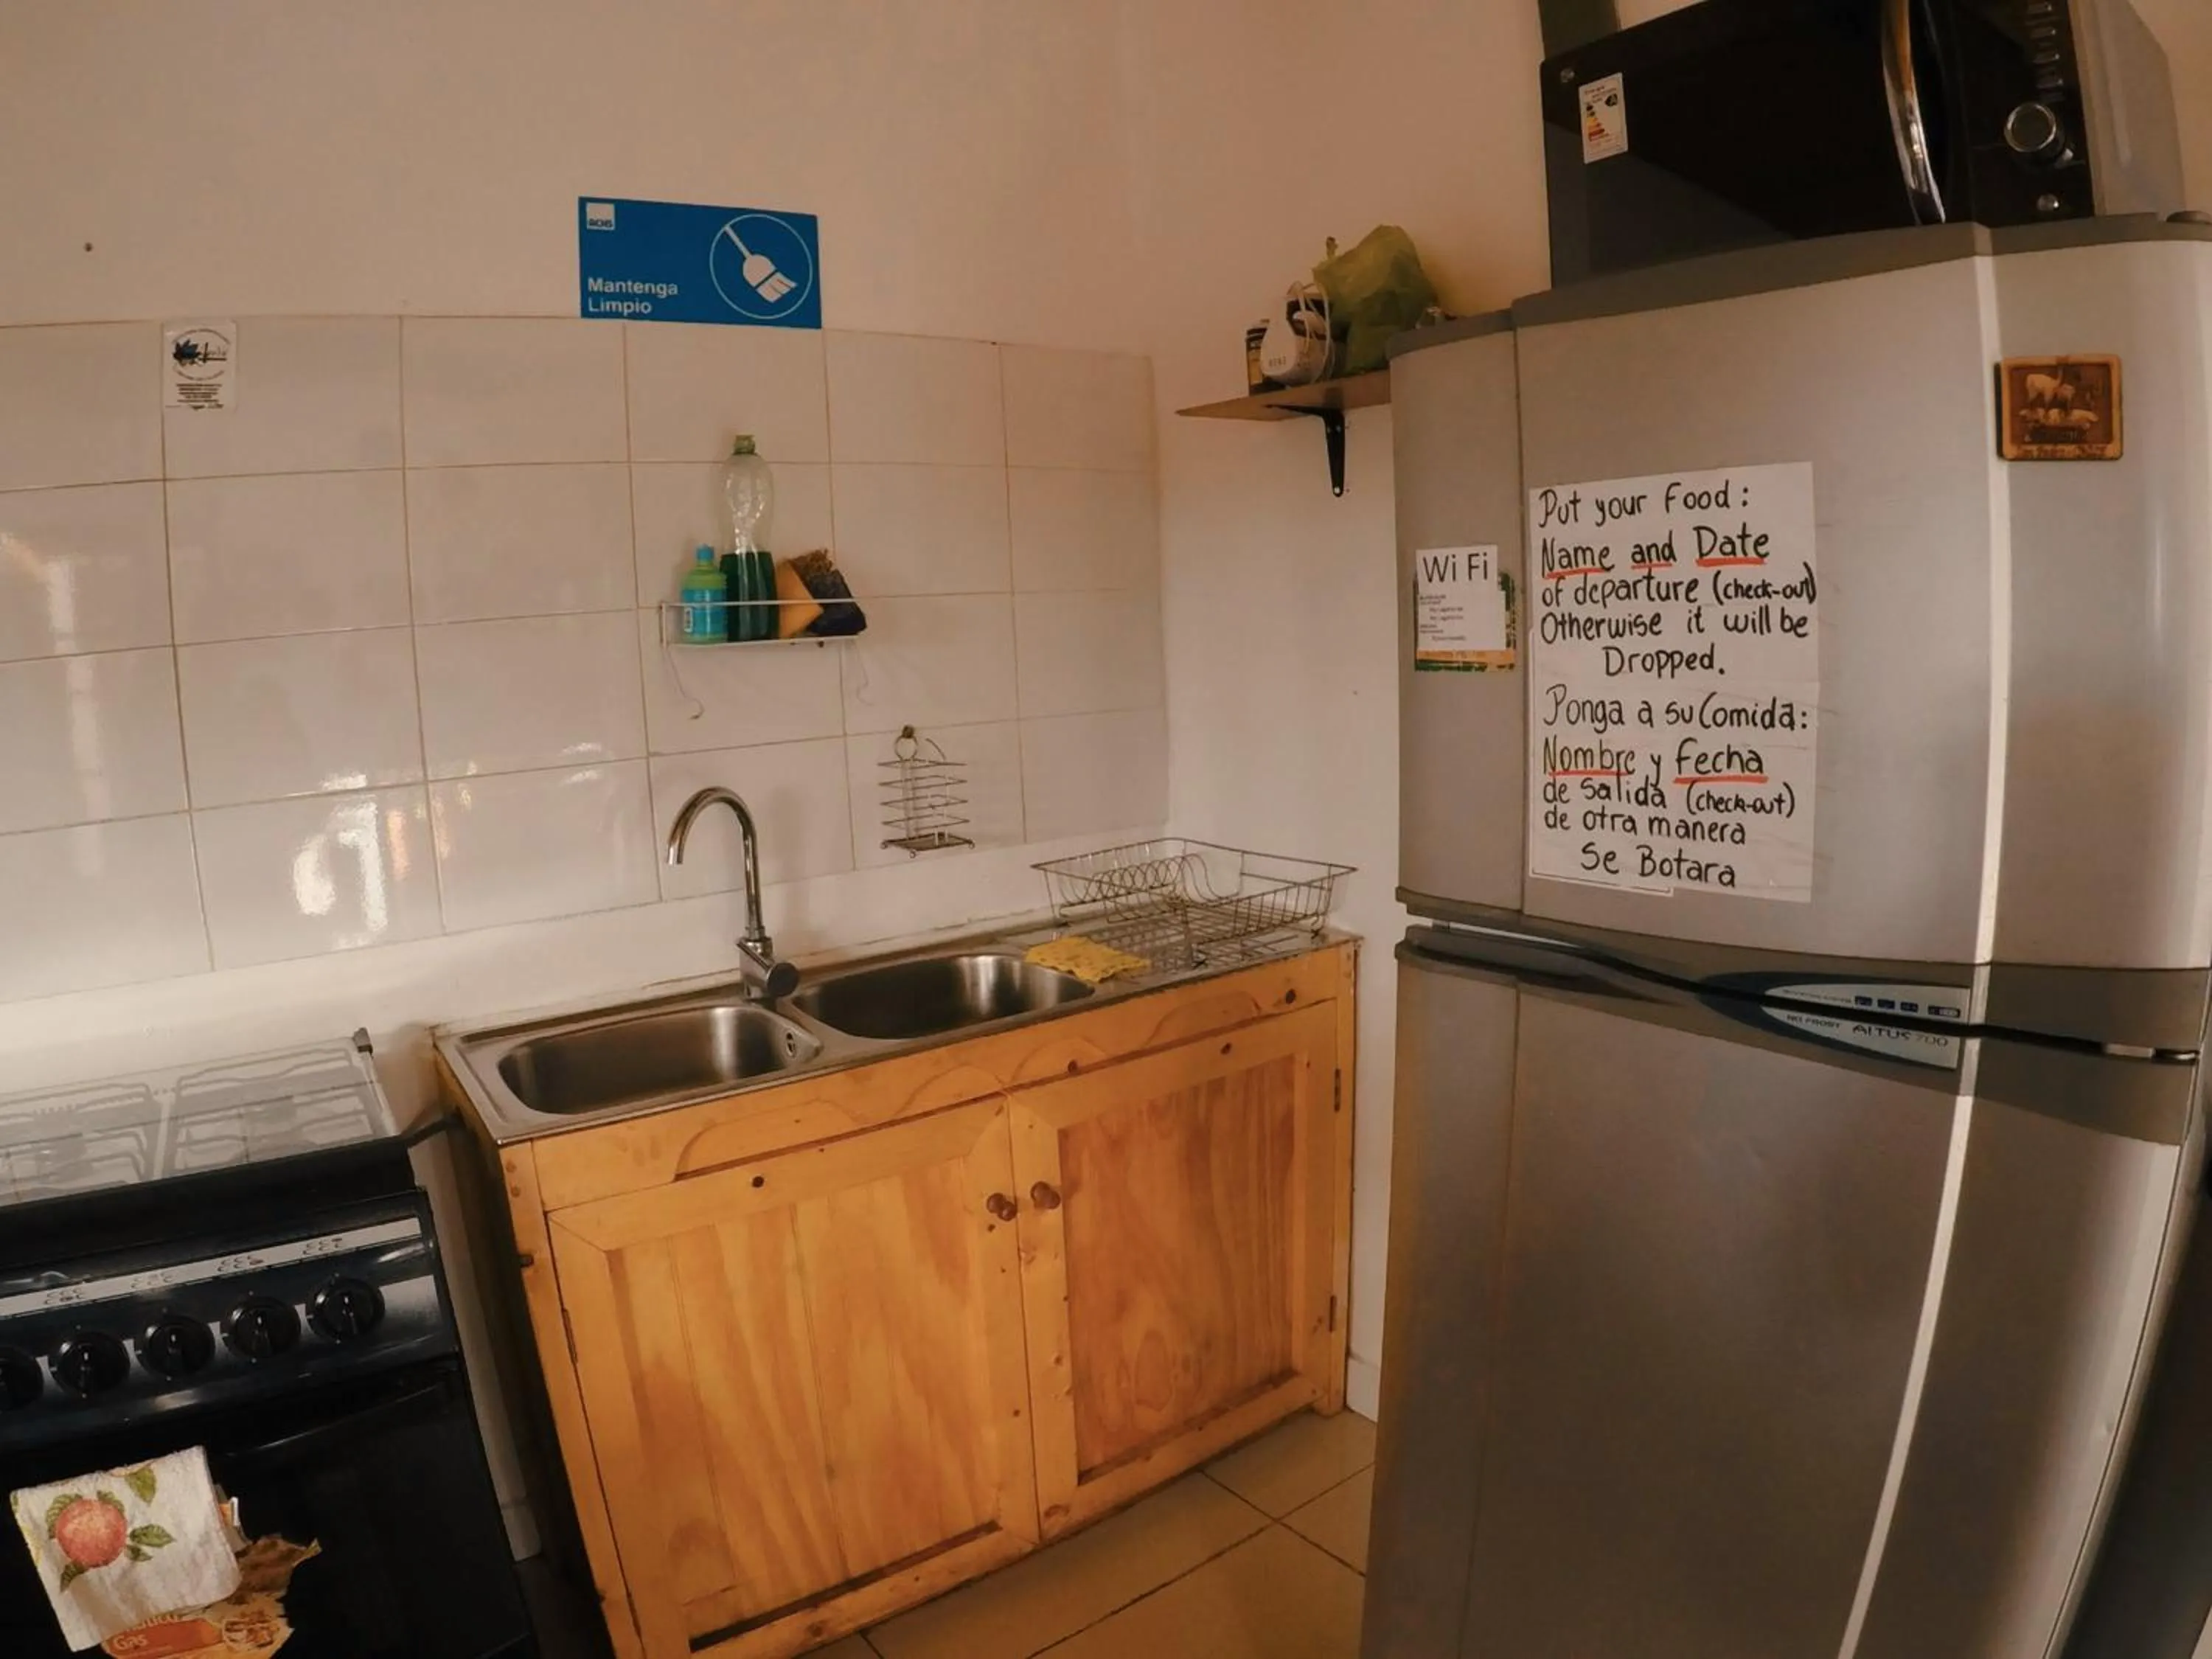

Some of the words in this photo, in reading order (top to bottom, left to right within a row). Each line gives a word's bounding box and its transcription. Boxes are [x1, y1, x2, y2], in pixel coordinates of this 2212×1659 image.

[588, 277, 678, 299] Mantenga
[588, 297, 652, 316] Limpio
[1539, 489, 1581, 527] Put
[1595, 495, 1647, 526] your
[1541, 538, 1615, 578] Name
[1631, 531, 1676, 564] and
[1693, 522, 1770, 558] Date
[1542, 575, 1565, 607] of
[1575, 568, 1699, 609] departure
[1540, 610, 1662, 643] Otherwise
[1688, 605, 1705, 633] it
[1723, 605, 1771, 636] will
[1781, 607, 1809, 637] be
[1602, 642, 1725, 678] Dropped.
[1543, 684, 1625, 734] Ponga
[1638, 701, 1654, 727] a
[1665, 702, 1693, 725] su
[1543, 736, 1635, 776] Nombre
[1650, 753, 1662, 787] y
[1676, 737, 1764, 775] Fecha
[1543, 778, 1571, 804] de
[1545, 809, 1571, 830] de
[1582, 807, 1638, 836] otra
[1648, 815, 1746, 845] manera
[1635, 845, 1736, 887] Botara
